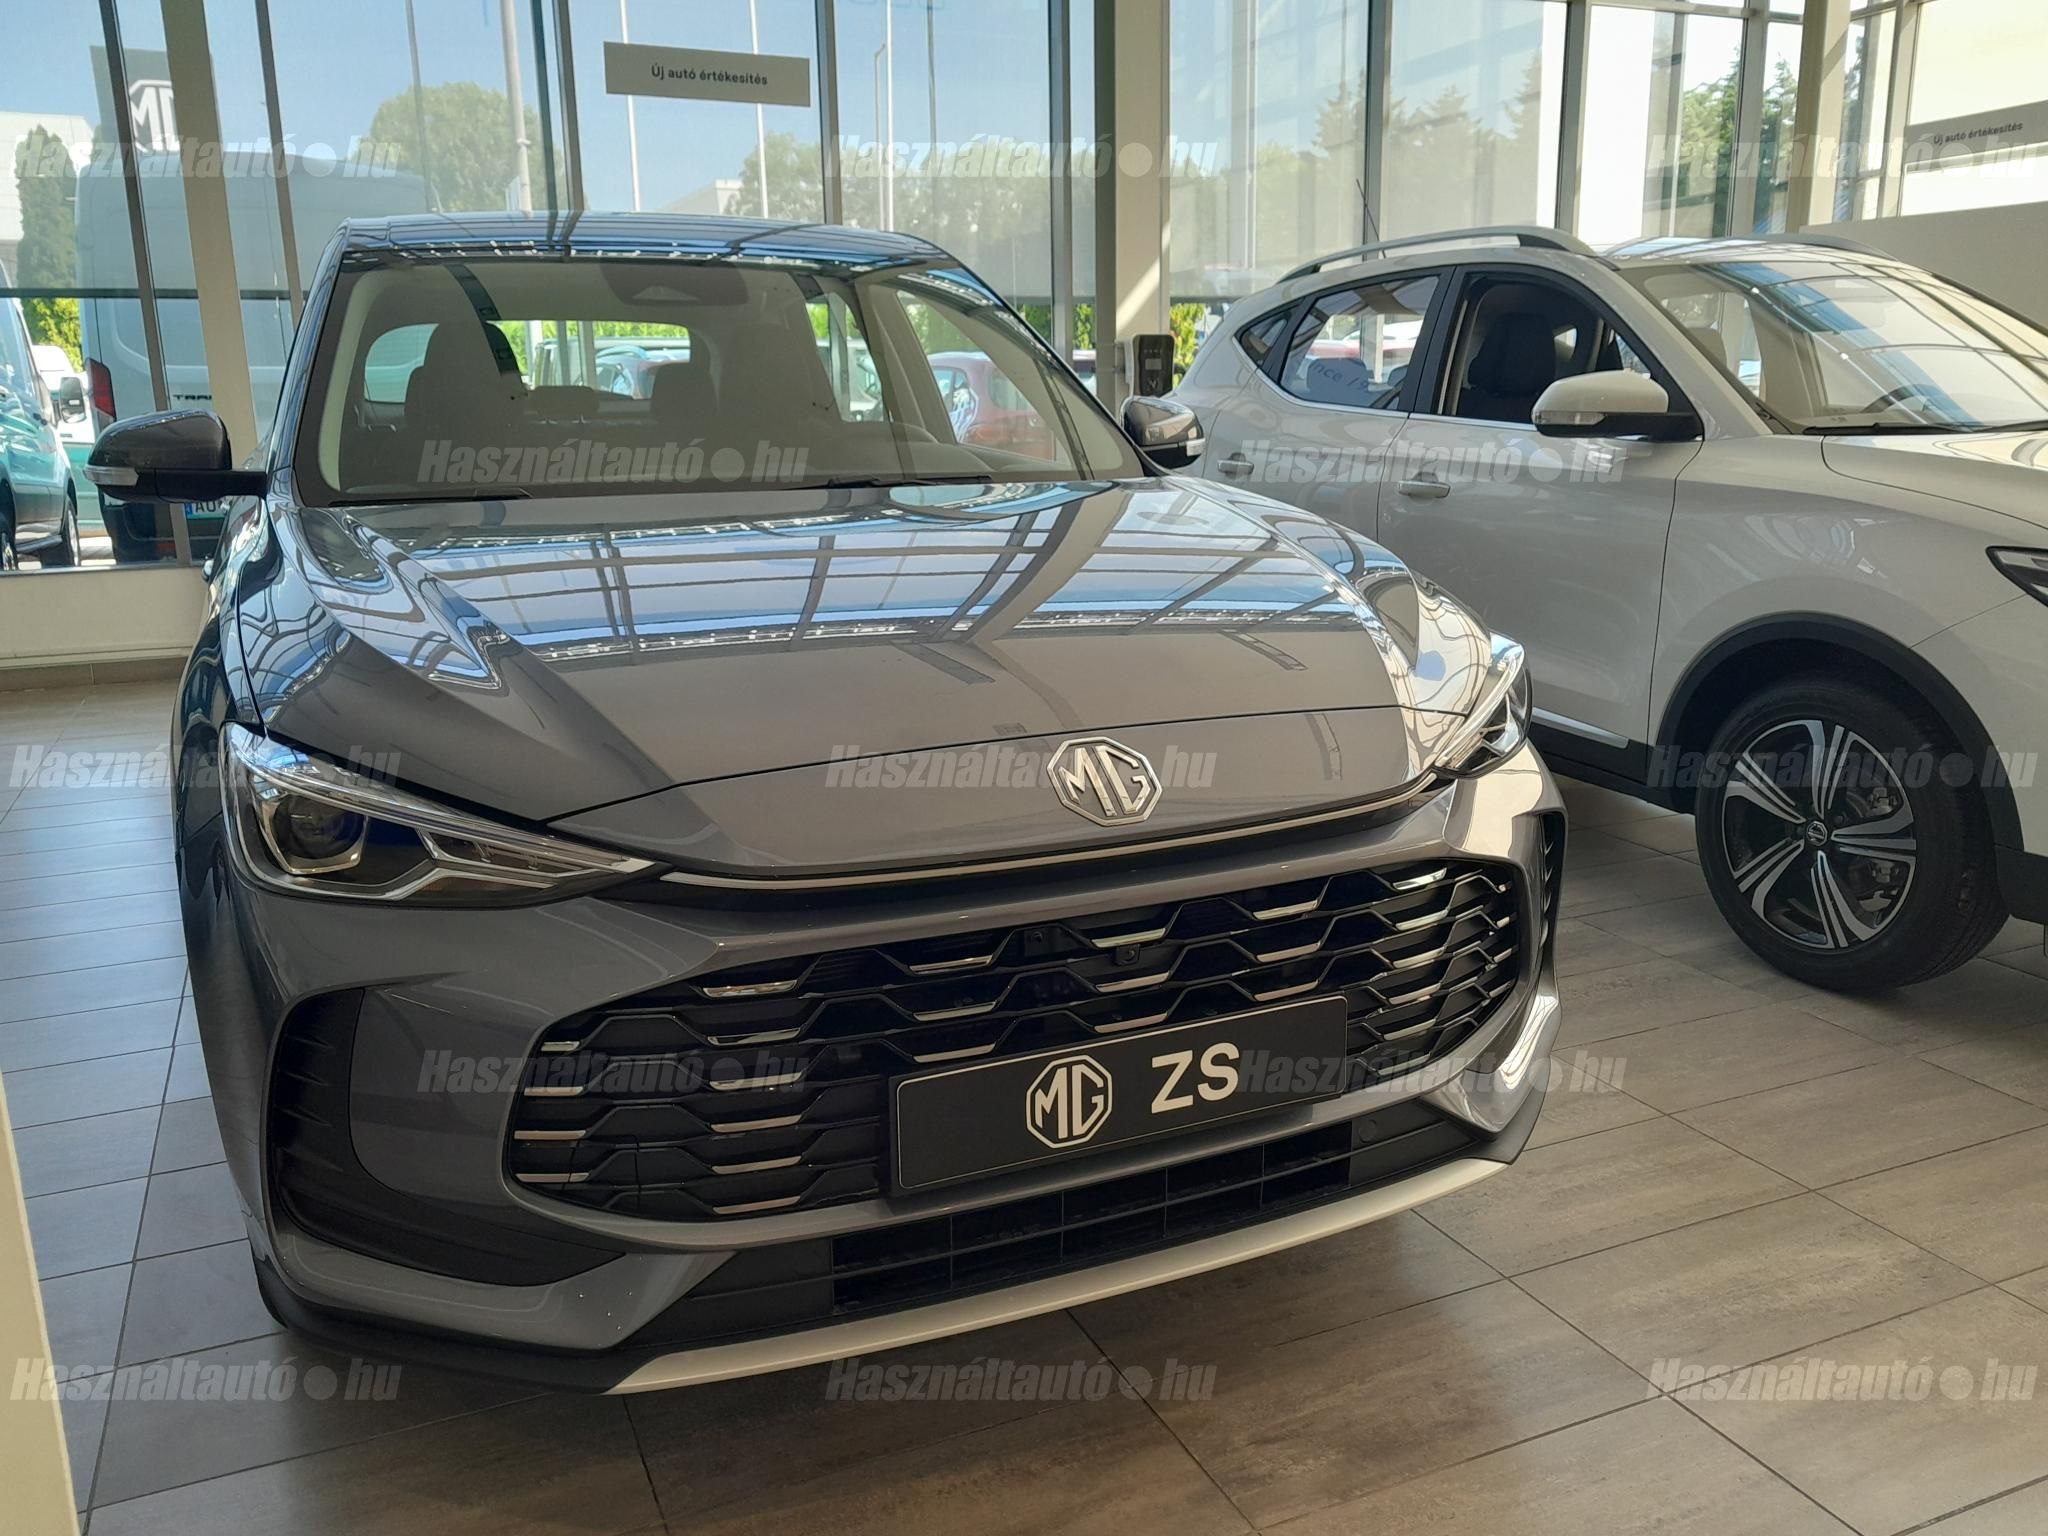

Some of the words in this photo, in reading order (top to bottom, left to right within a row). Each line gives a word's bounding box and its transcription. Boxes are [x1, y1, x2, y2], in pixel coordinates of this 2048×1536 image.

[651, 62, 664, 80] Új
[668, 67, 696, 80] autó
[699, 68, 768, 85] értékesítés
[1058, 744, 1152, 817] MG
[1034, 1063, 1105, 1140] MG
[1151, 1042, 1240, 1115] ZS
